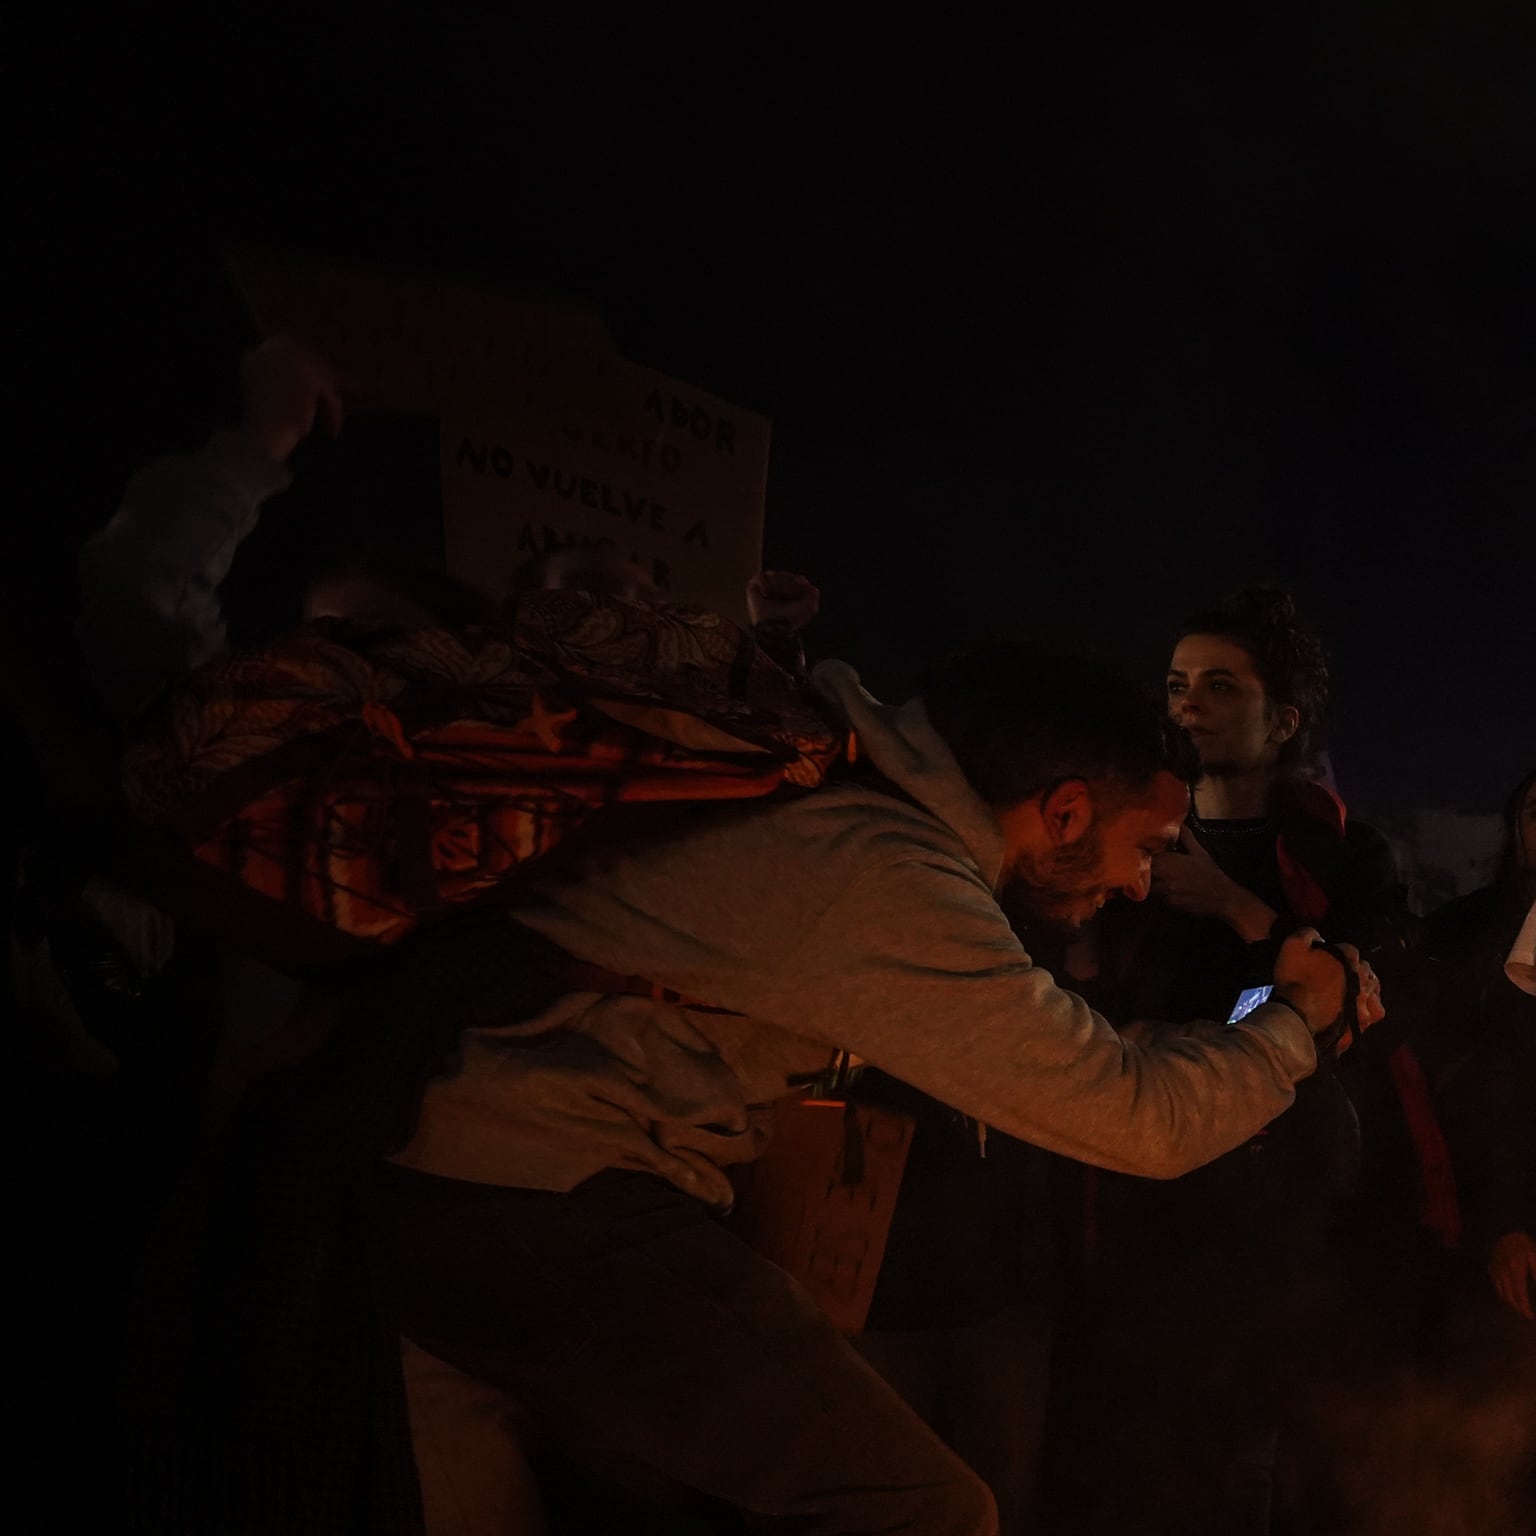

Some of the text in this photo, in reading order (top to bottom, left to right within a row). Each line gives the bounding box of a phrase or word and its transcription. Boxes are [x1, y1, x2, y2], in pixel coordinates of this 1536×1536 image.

[456, 436, 709, 549] NO VUELVE A
